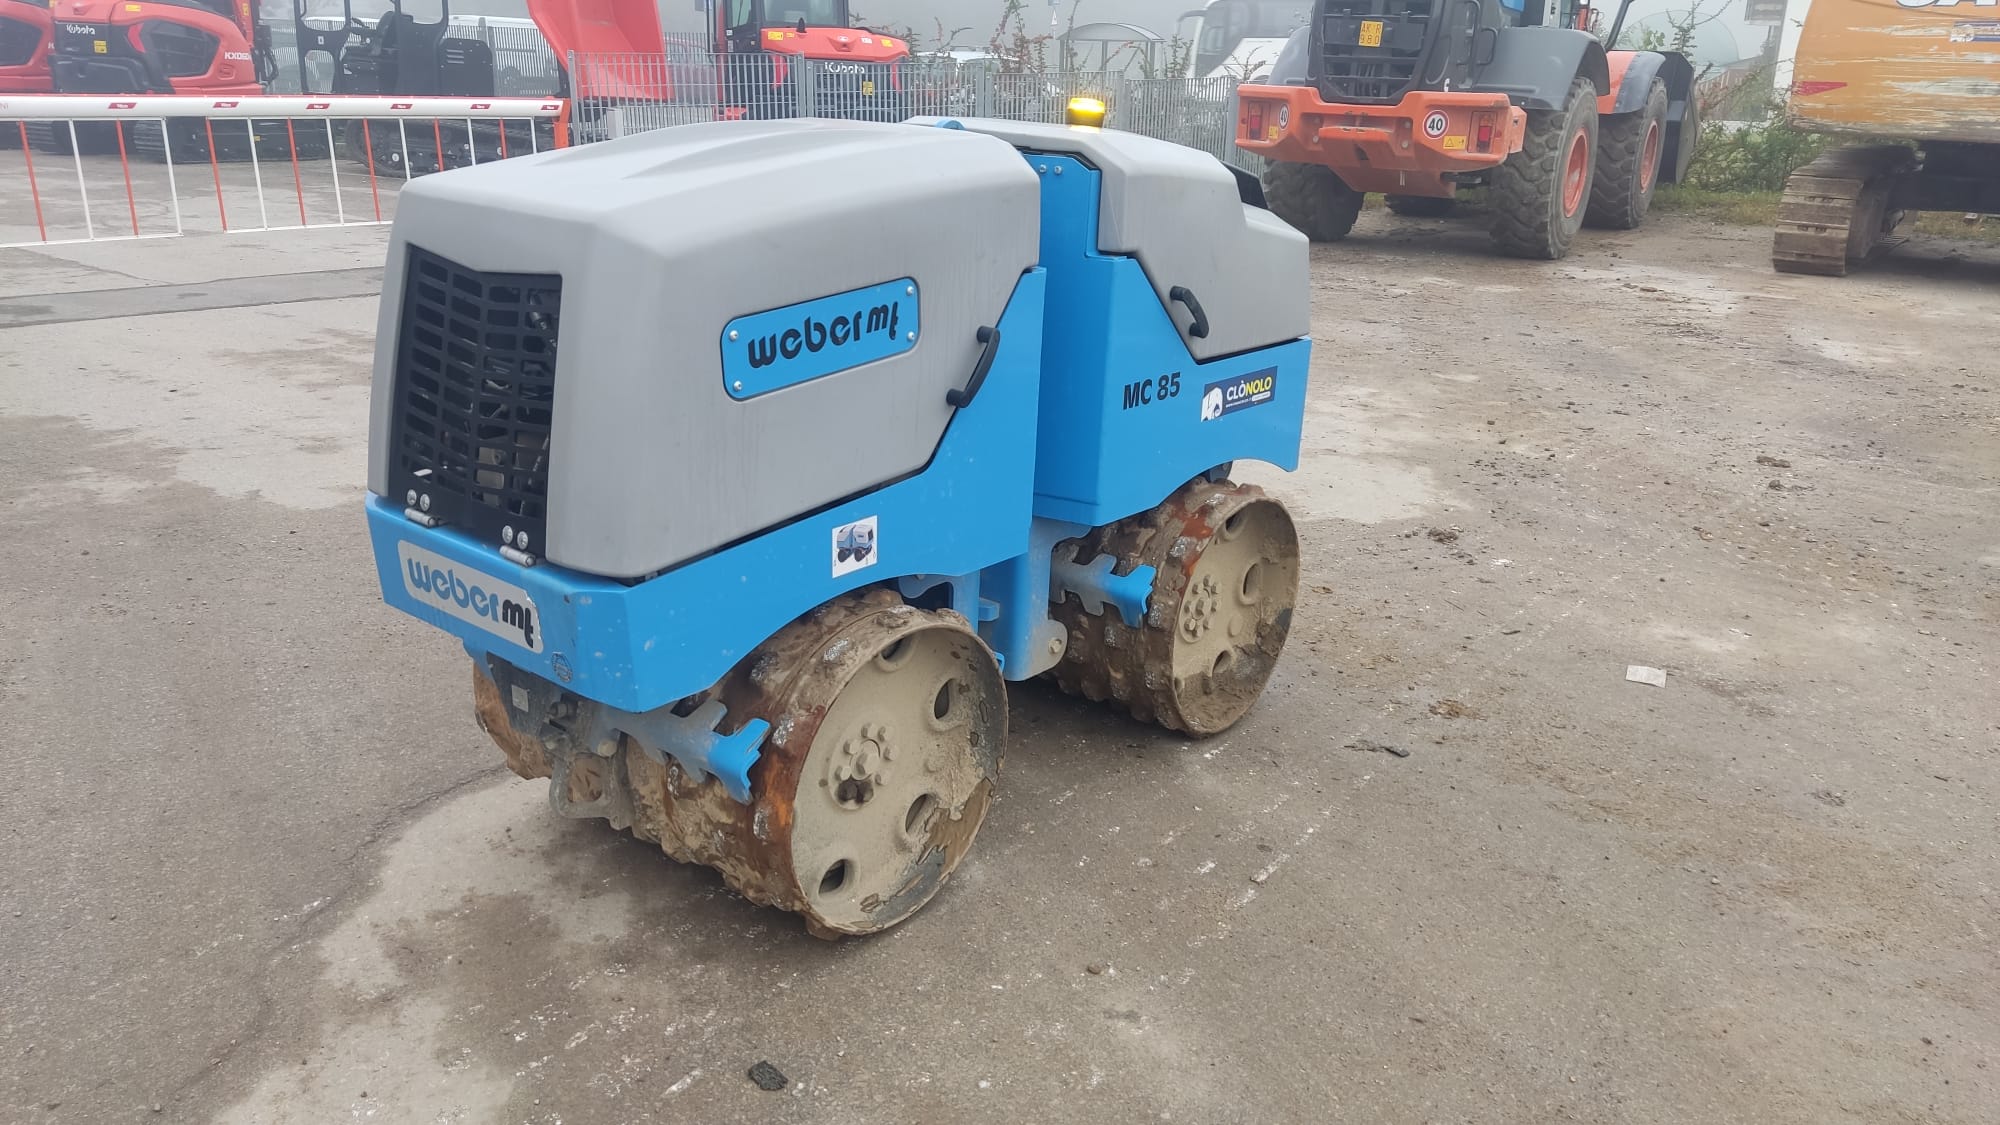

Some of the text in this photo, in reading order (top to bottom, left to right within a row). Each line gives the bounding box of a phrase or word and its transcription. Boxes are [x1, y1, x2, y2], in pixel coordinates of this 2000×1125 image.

[66, 24, 96, 35] Kubota
[825, 62, 865, 74] Kubota
[1428, 117, 1443, 131] 40
[1123, 371, 1181, 410] MC 85
[1226, 376, 1272, 401] CLÒNOLO
